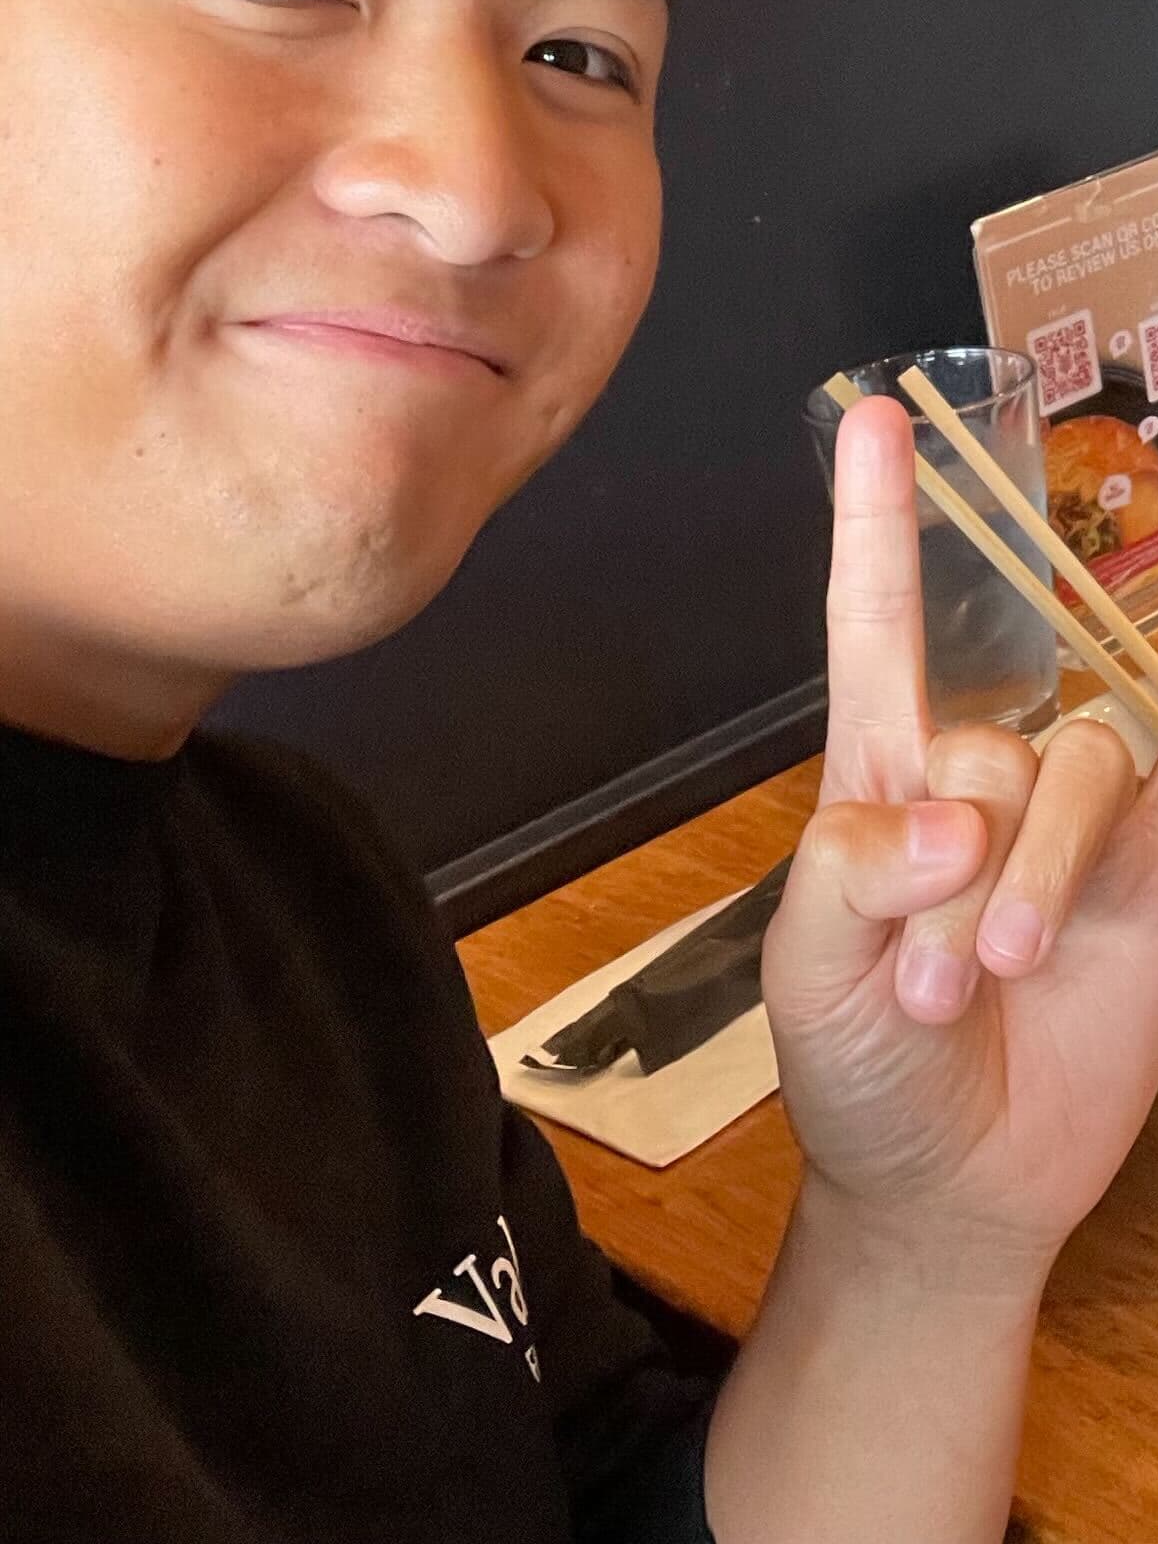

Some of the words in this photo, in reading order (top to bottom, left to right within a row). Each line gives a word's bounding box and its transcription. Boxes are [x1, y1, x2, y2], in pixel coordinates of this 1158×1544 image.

[1006, 249, 1068, 287] PLEASE
[1071, 231, 1113, 260] SCAN
[1032, 276, 1053, 297] TO
[1056, 251, 1116, 287] REVIEW
[1119, 240, 1140, 260] US
